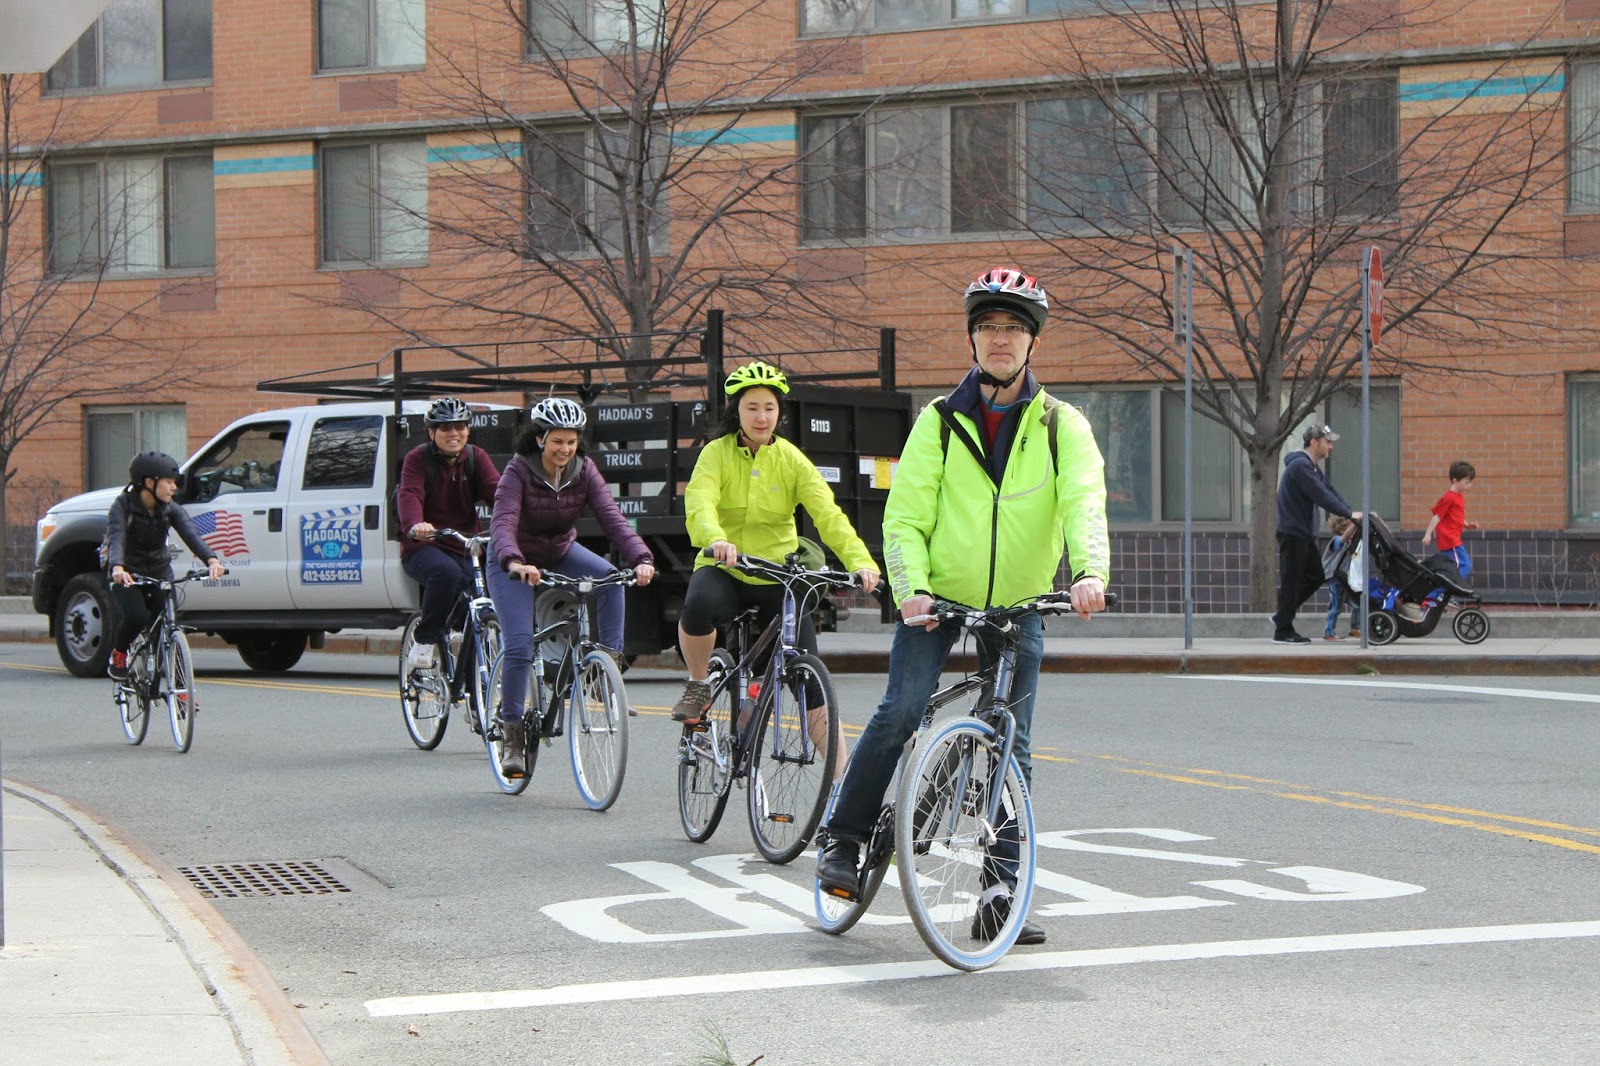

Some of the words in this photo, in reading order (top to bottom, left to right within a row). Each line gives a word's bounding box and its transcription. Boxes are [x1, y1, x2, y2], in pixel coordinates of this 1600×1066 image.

[1369, 279, 1382, 315] STOP
[598, 407, 653, 421] HADDAD'S
[811, 419, 830, 433] 51113
[605, 453, 643, 467] TRUCK
[304, 528, 358, 546] HADDAD'S
[303, 569, 361, 582] 412-655-8822
